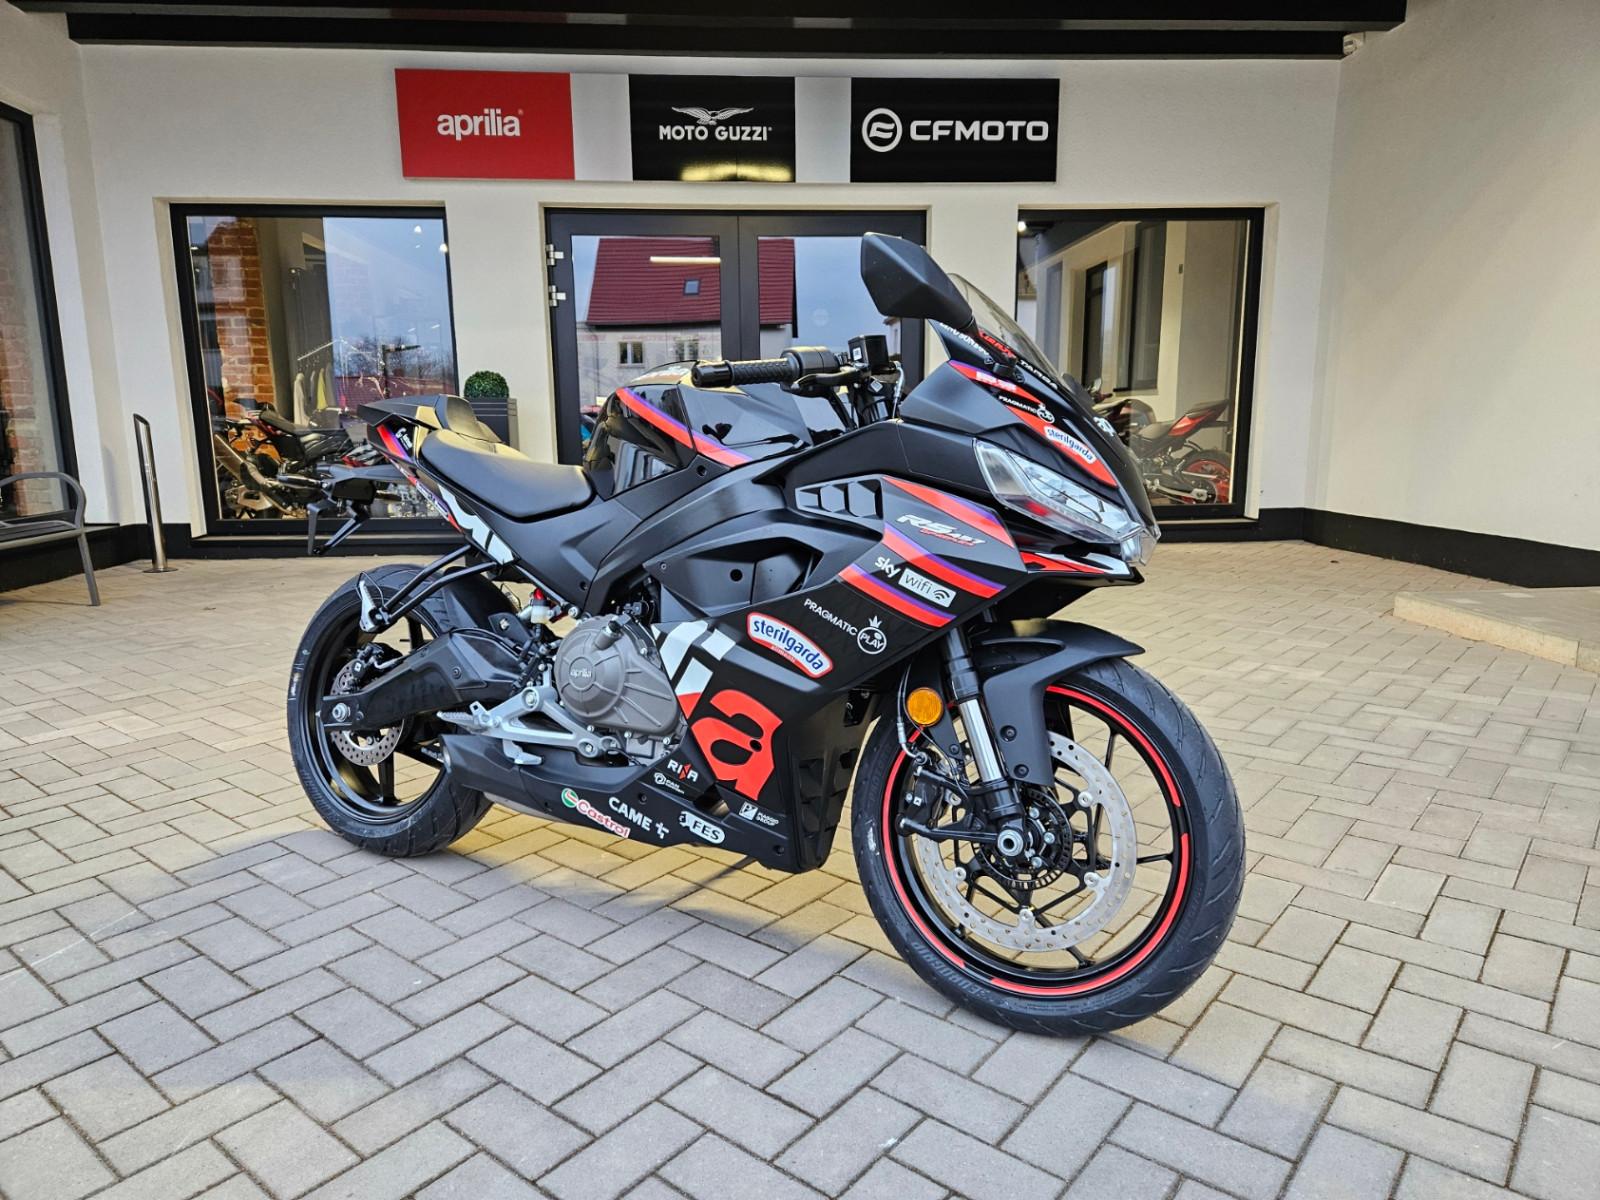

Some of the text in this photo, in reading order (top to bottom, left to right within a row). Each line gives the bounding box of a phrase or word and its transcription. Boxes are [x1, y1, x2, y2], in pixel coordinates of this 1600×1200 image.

[437, 108, 521, 141] aprilia
[659, 125, 768, 141] MOTO GUZZI
[909, 120, 1049, 142] CFMOTO
[1046, 427, 1095, 461] sterilgarda
[874, 556, 934, 594] sky wifi
[803, 597, 858, 637] PRAGMATIC
[753, 618, 825, 671] sterilgarda
[859, 631, 885, 650] PLAY
[667, 759, 699, 782] RINA
[576, 798, 632, 838] Castrol
[608, 796, 653, 831] CAME
[692, 819, 721, 841] FES
